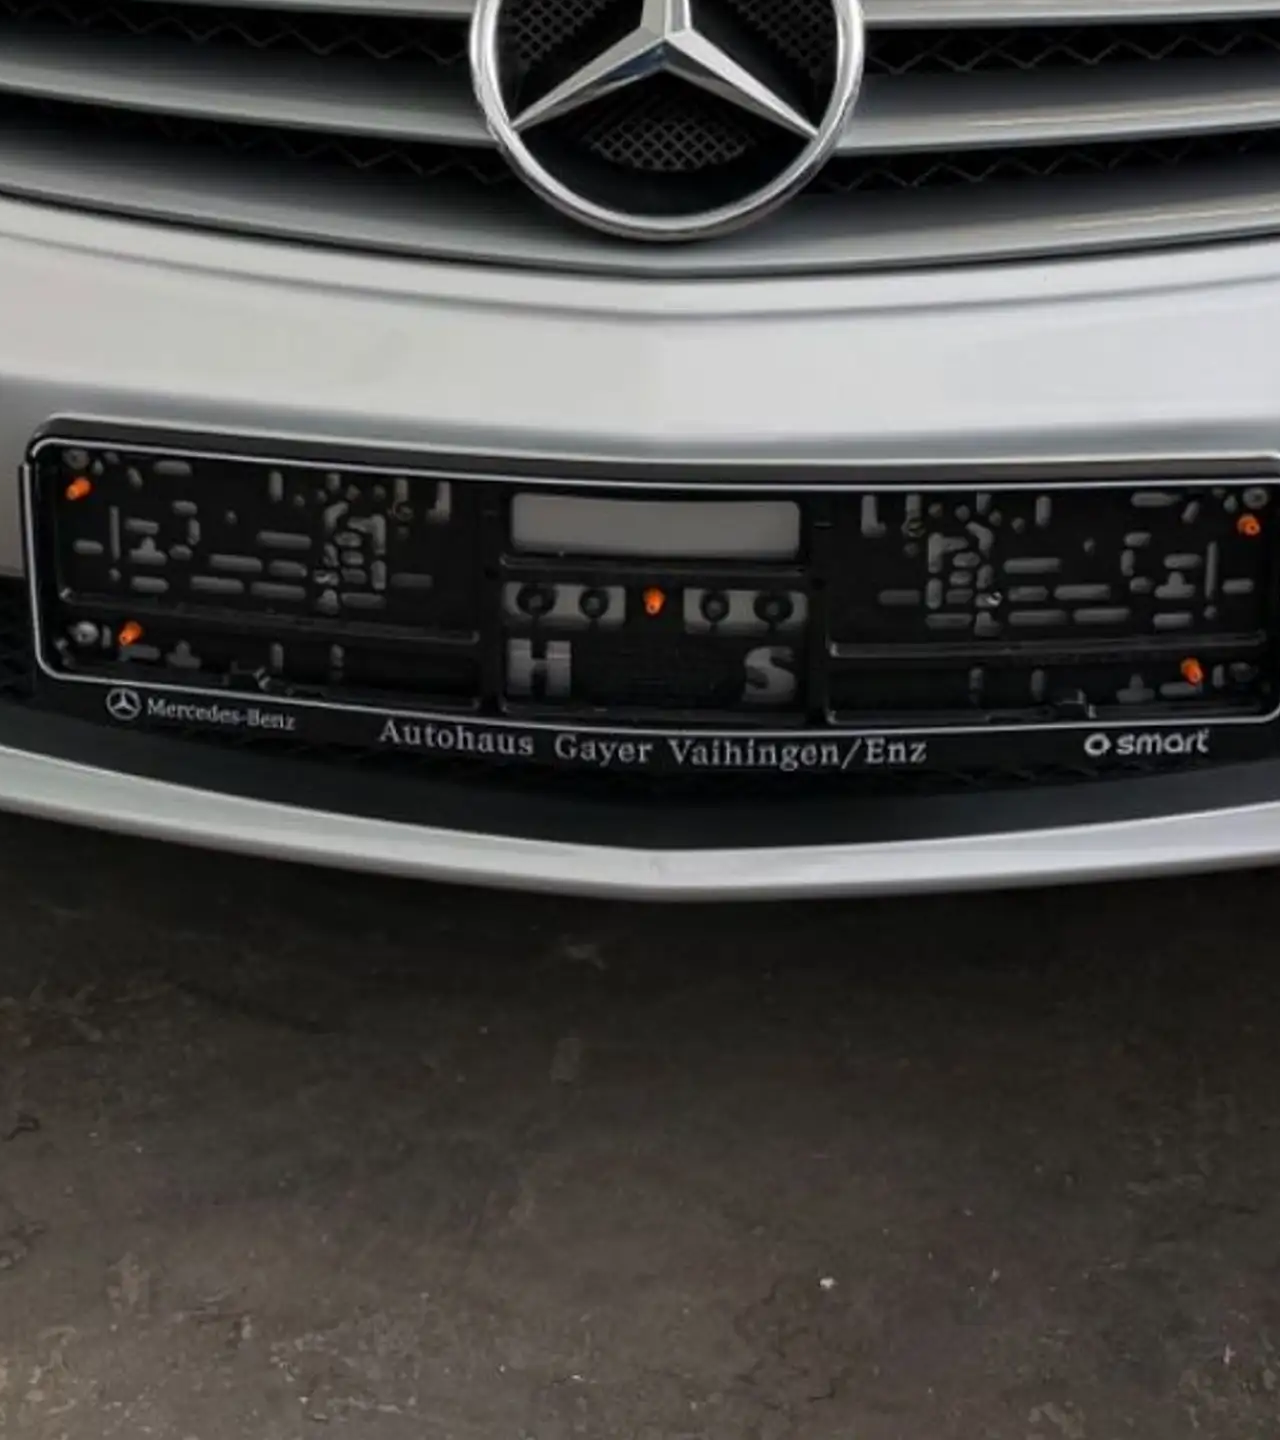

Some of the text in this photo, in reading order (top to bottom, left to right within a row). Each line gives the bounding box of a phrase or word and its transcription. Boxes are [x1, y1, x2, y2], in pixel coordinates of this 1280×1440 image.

[146, 696, 296, 731] Mercedes-Benz
[379, 718, 927, 771] Autohaus Gayer Vaihingen/Enz
[1116, 728, 1209, 755] smart
